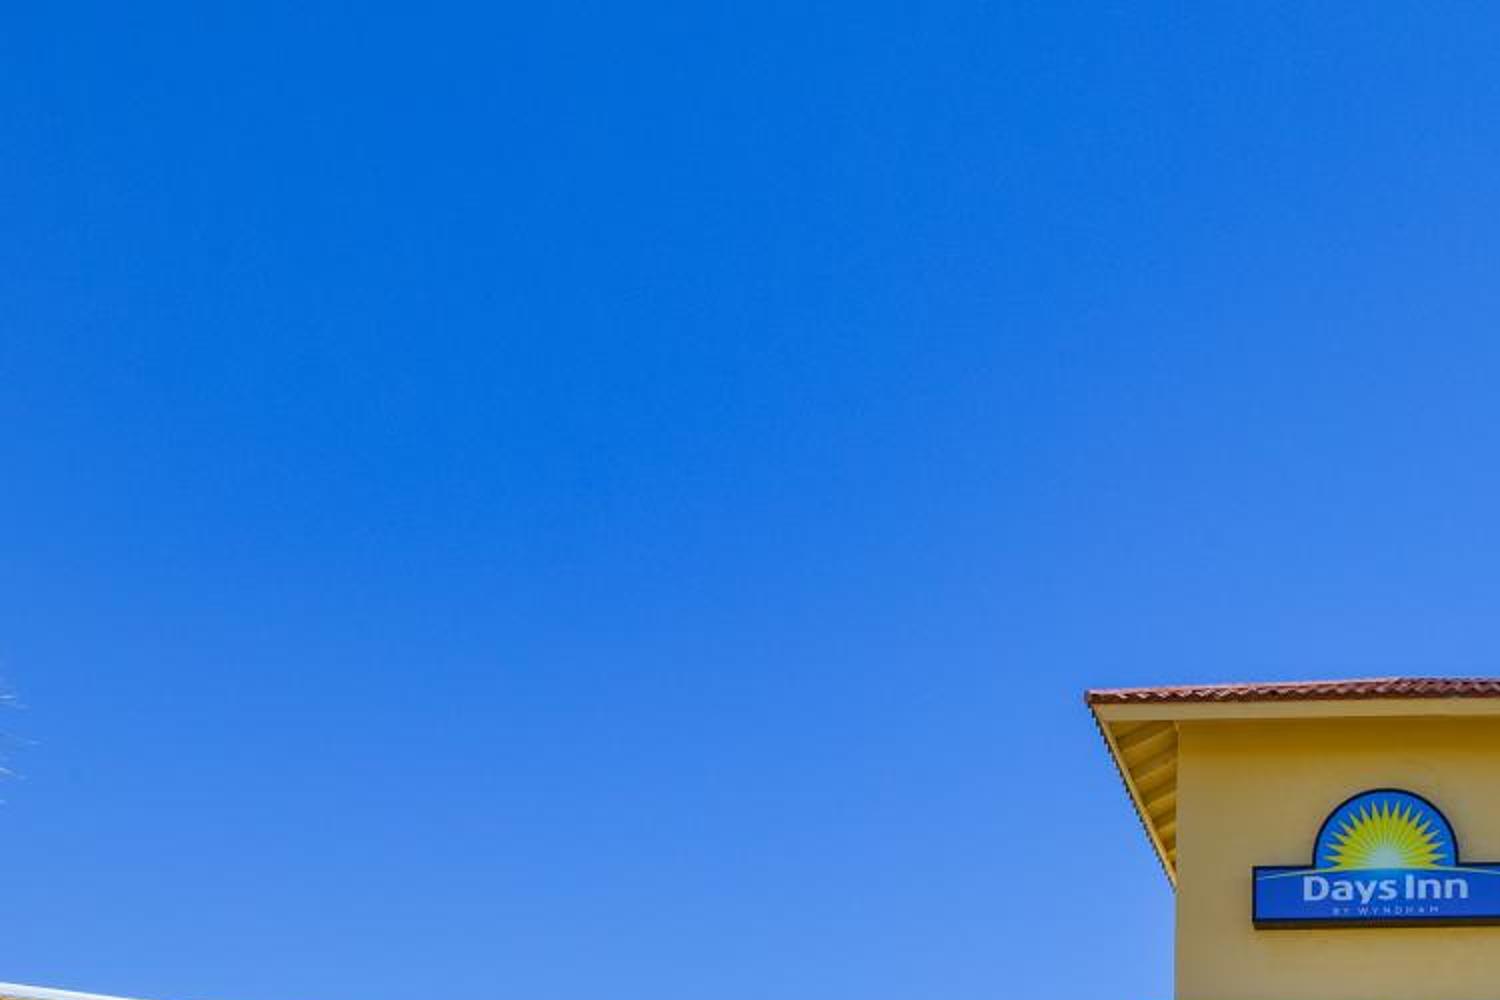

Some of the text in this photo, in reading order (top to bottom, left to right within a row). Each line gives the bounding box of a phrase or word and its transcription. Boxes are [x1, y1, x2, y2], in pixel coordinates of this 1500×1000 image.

[1303, 874, 1469, 904] Days Inn
[1358, 905, 1440, 916] WYNDHAM
